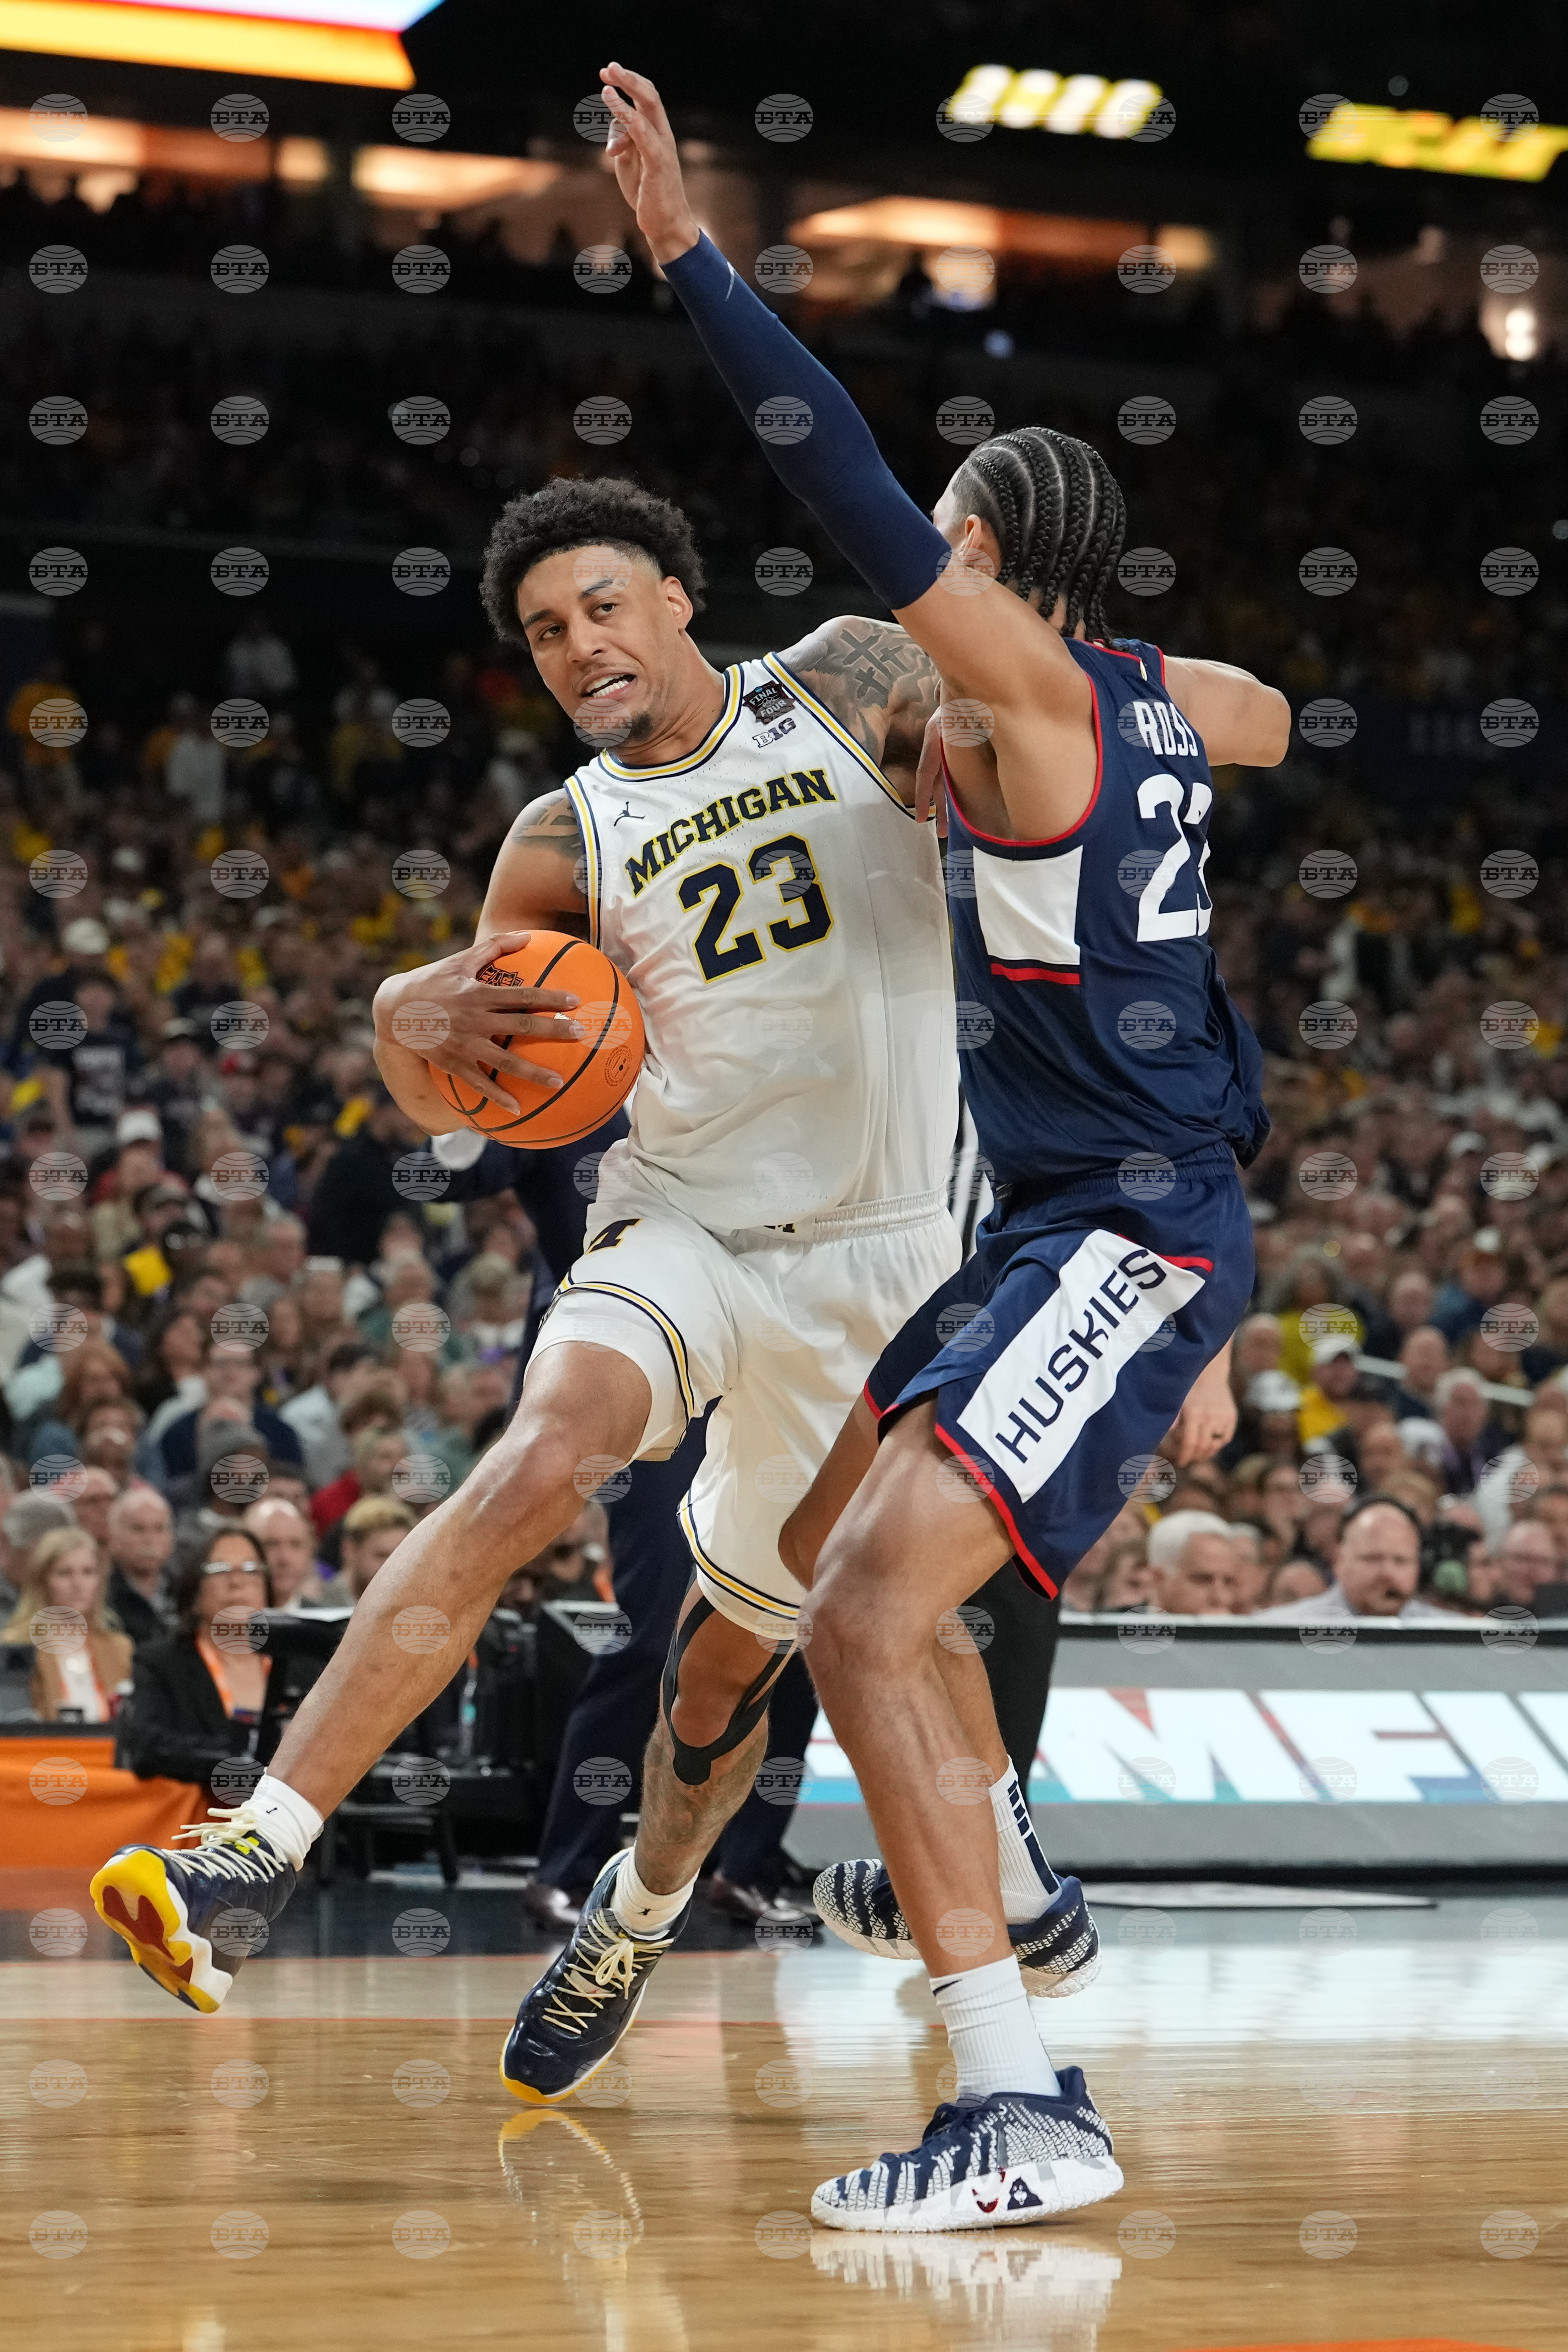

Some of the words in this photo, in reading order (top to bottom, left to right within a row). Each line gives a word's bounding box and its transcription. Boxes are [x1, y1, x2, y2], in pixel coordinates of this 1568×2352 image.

[749, 687, 777, 706] FINAL
[760, 700, 787, 717] FOUR
[624, 769, 838, 899] MICHIGAN
[676, 832, 834, 984] 23
[995, 1249, 1167, 1464] HUSKIES
